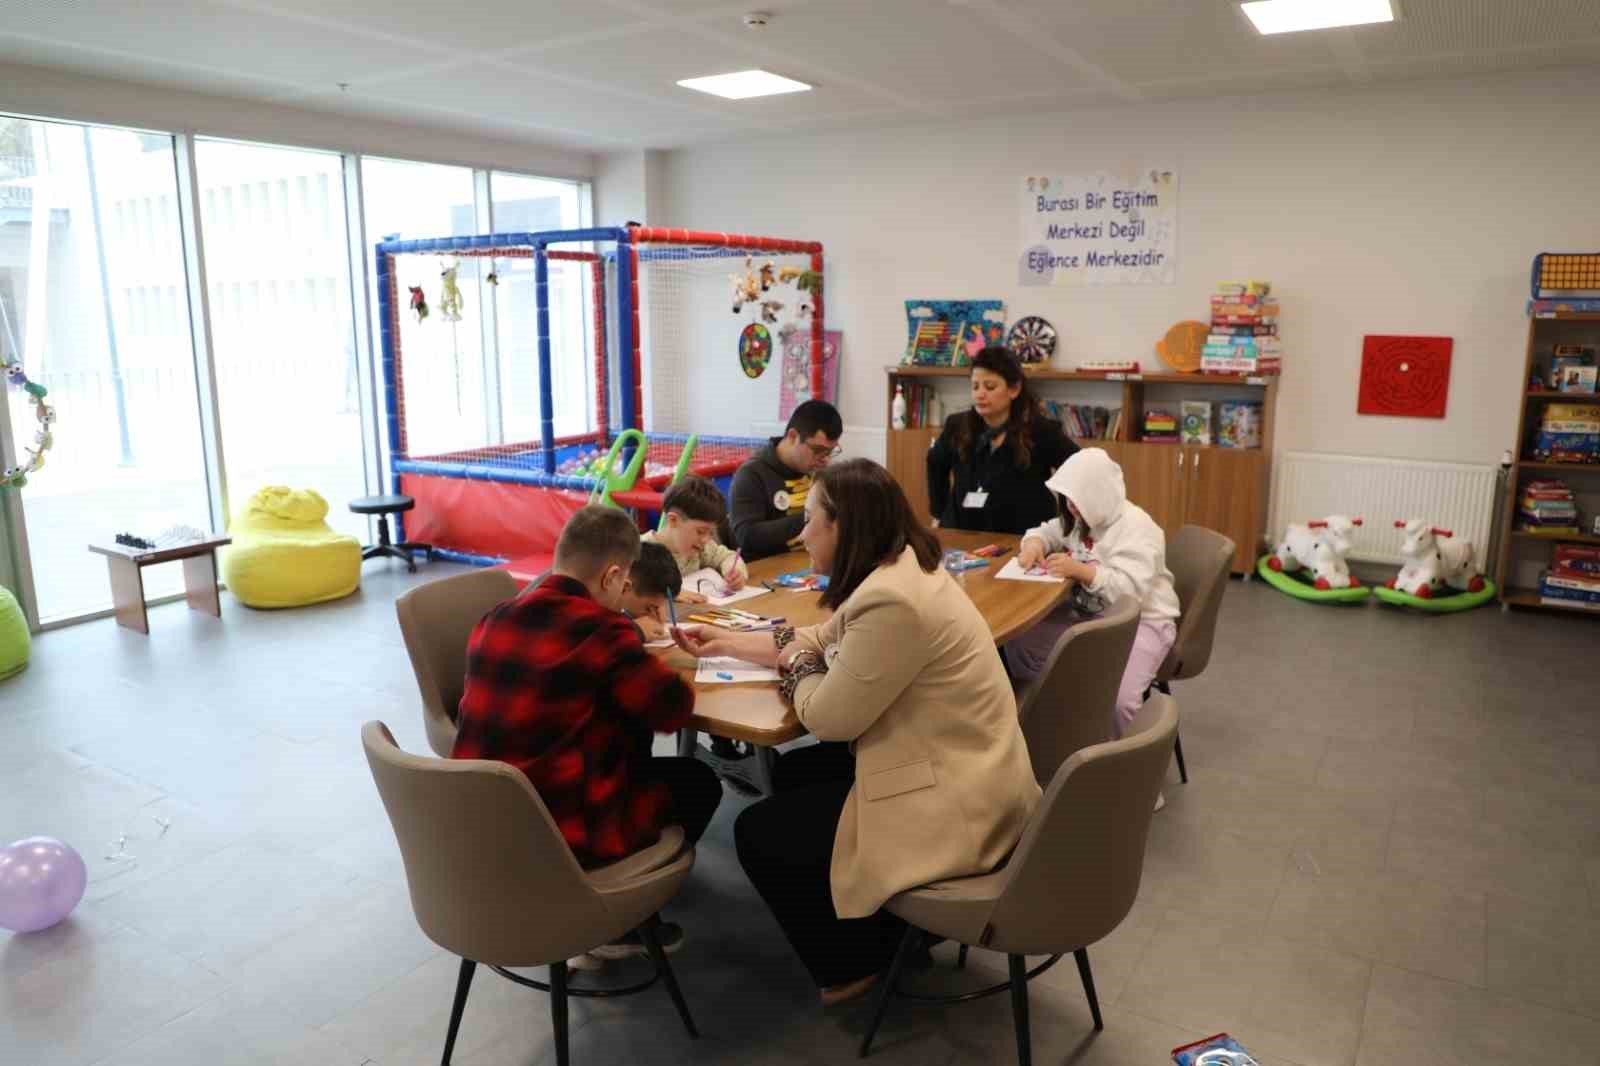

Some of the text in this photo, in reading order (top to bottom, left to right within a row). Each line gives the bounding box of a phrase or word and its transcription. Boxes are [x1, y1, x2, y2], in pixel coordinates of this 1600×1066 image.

[1037, 190, 1158, 213] Burası Bir Eğitim
[1047, 219, 1145, 242] Merkezi Değil
[1028, 249, 1164, 273] Eğlence Merkezidir
